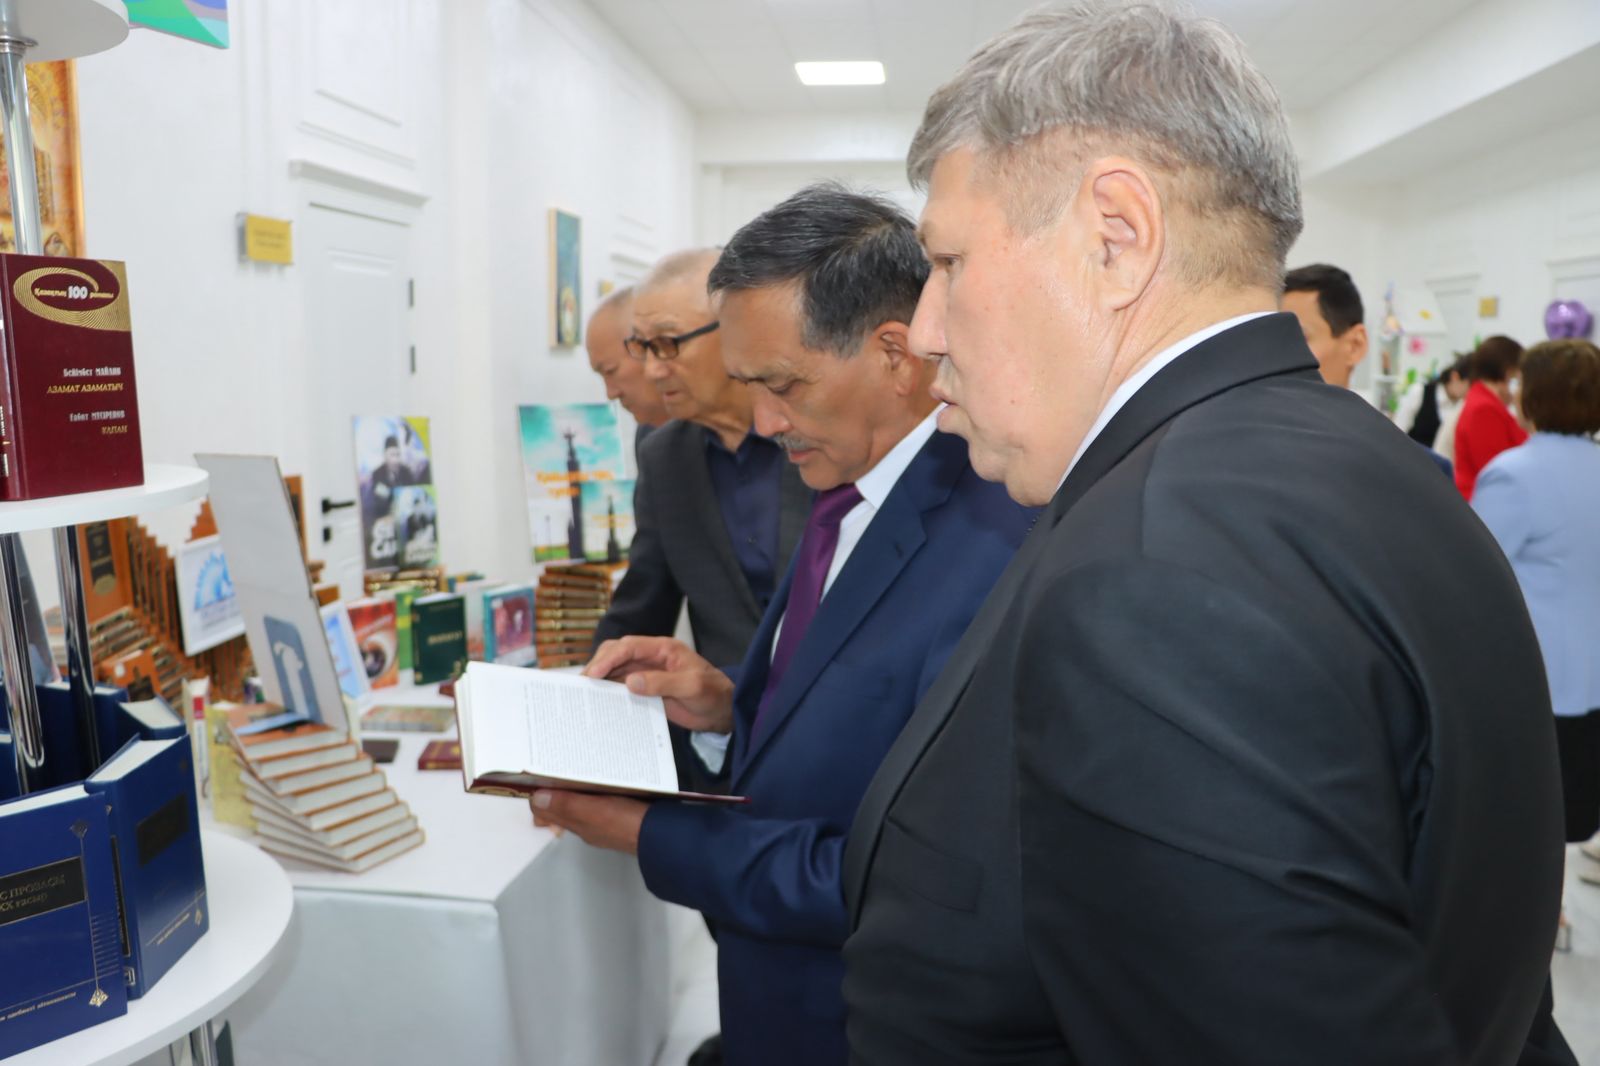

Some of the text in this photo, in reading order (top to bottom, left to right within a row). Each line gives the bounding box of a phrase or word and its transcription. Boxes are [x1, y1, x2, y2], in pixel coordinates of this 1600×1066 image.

[68, 285, 89, 299] 100
[47, 383, 124, 394] АЗАМАТ АЗАМАТЫЧ
